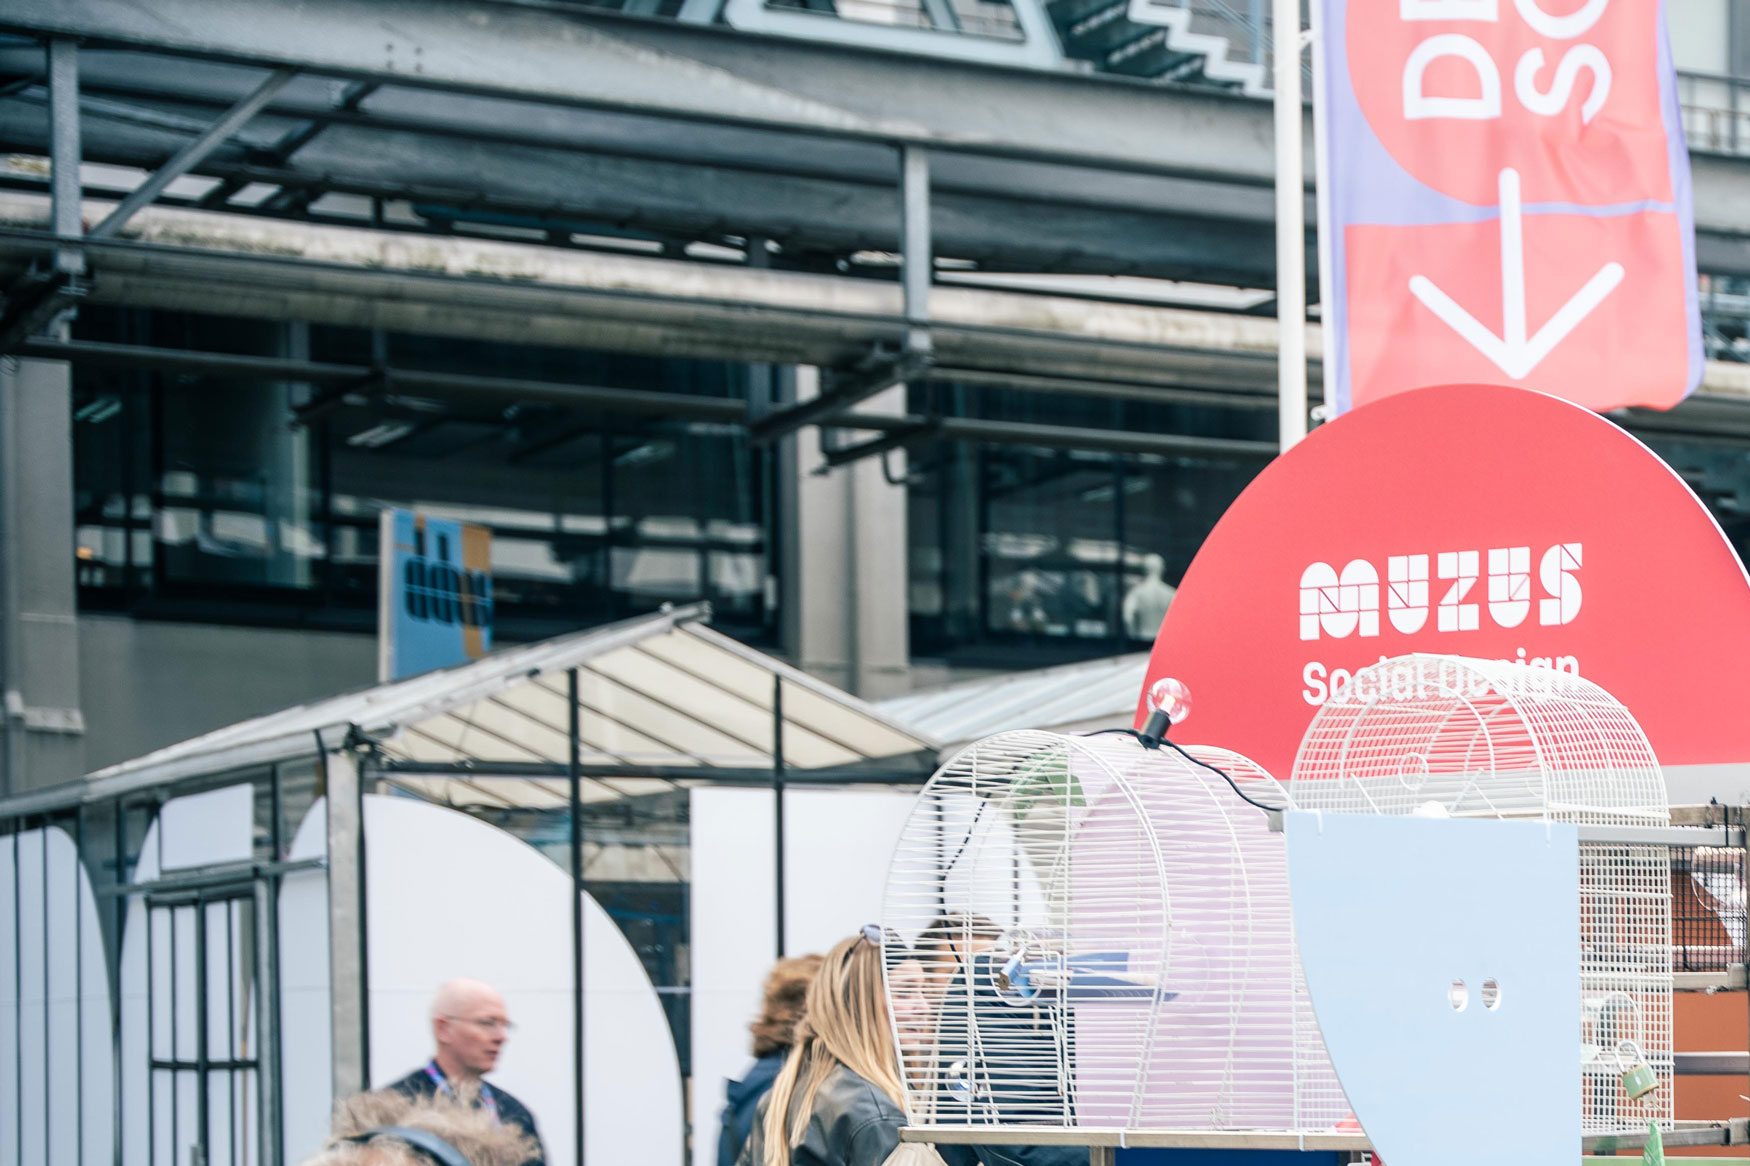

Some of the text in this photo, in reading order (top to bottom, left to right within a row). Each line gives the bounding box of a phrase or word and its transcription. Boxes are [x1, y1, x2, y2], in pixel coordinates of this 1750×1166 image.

[1400, 0, 1502, 119] D
[1300, 542, 1582, 640] MUZUS
[1302, 647, 1579, 705] Social Deign
